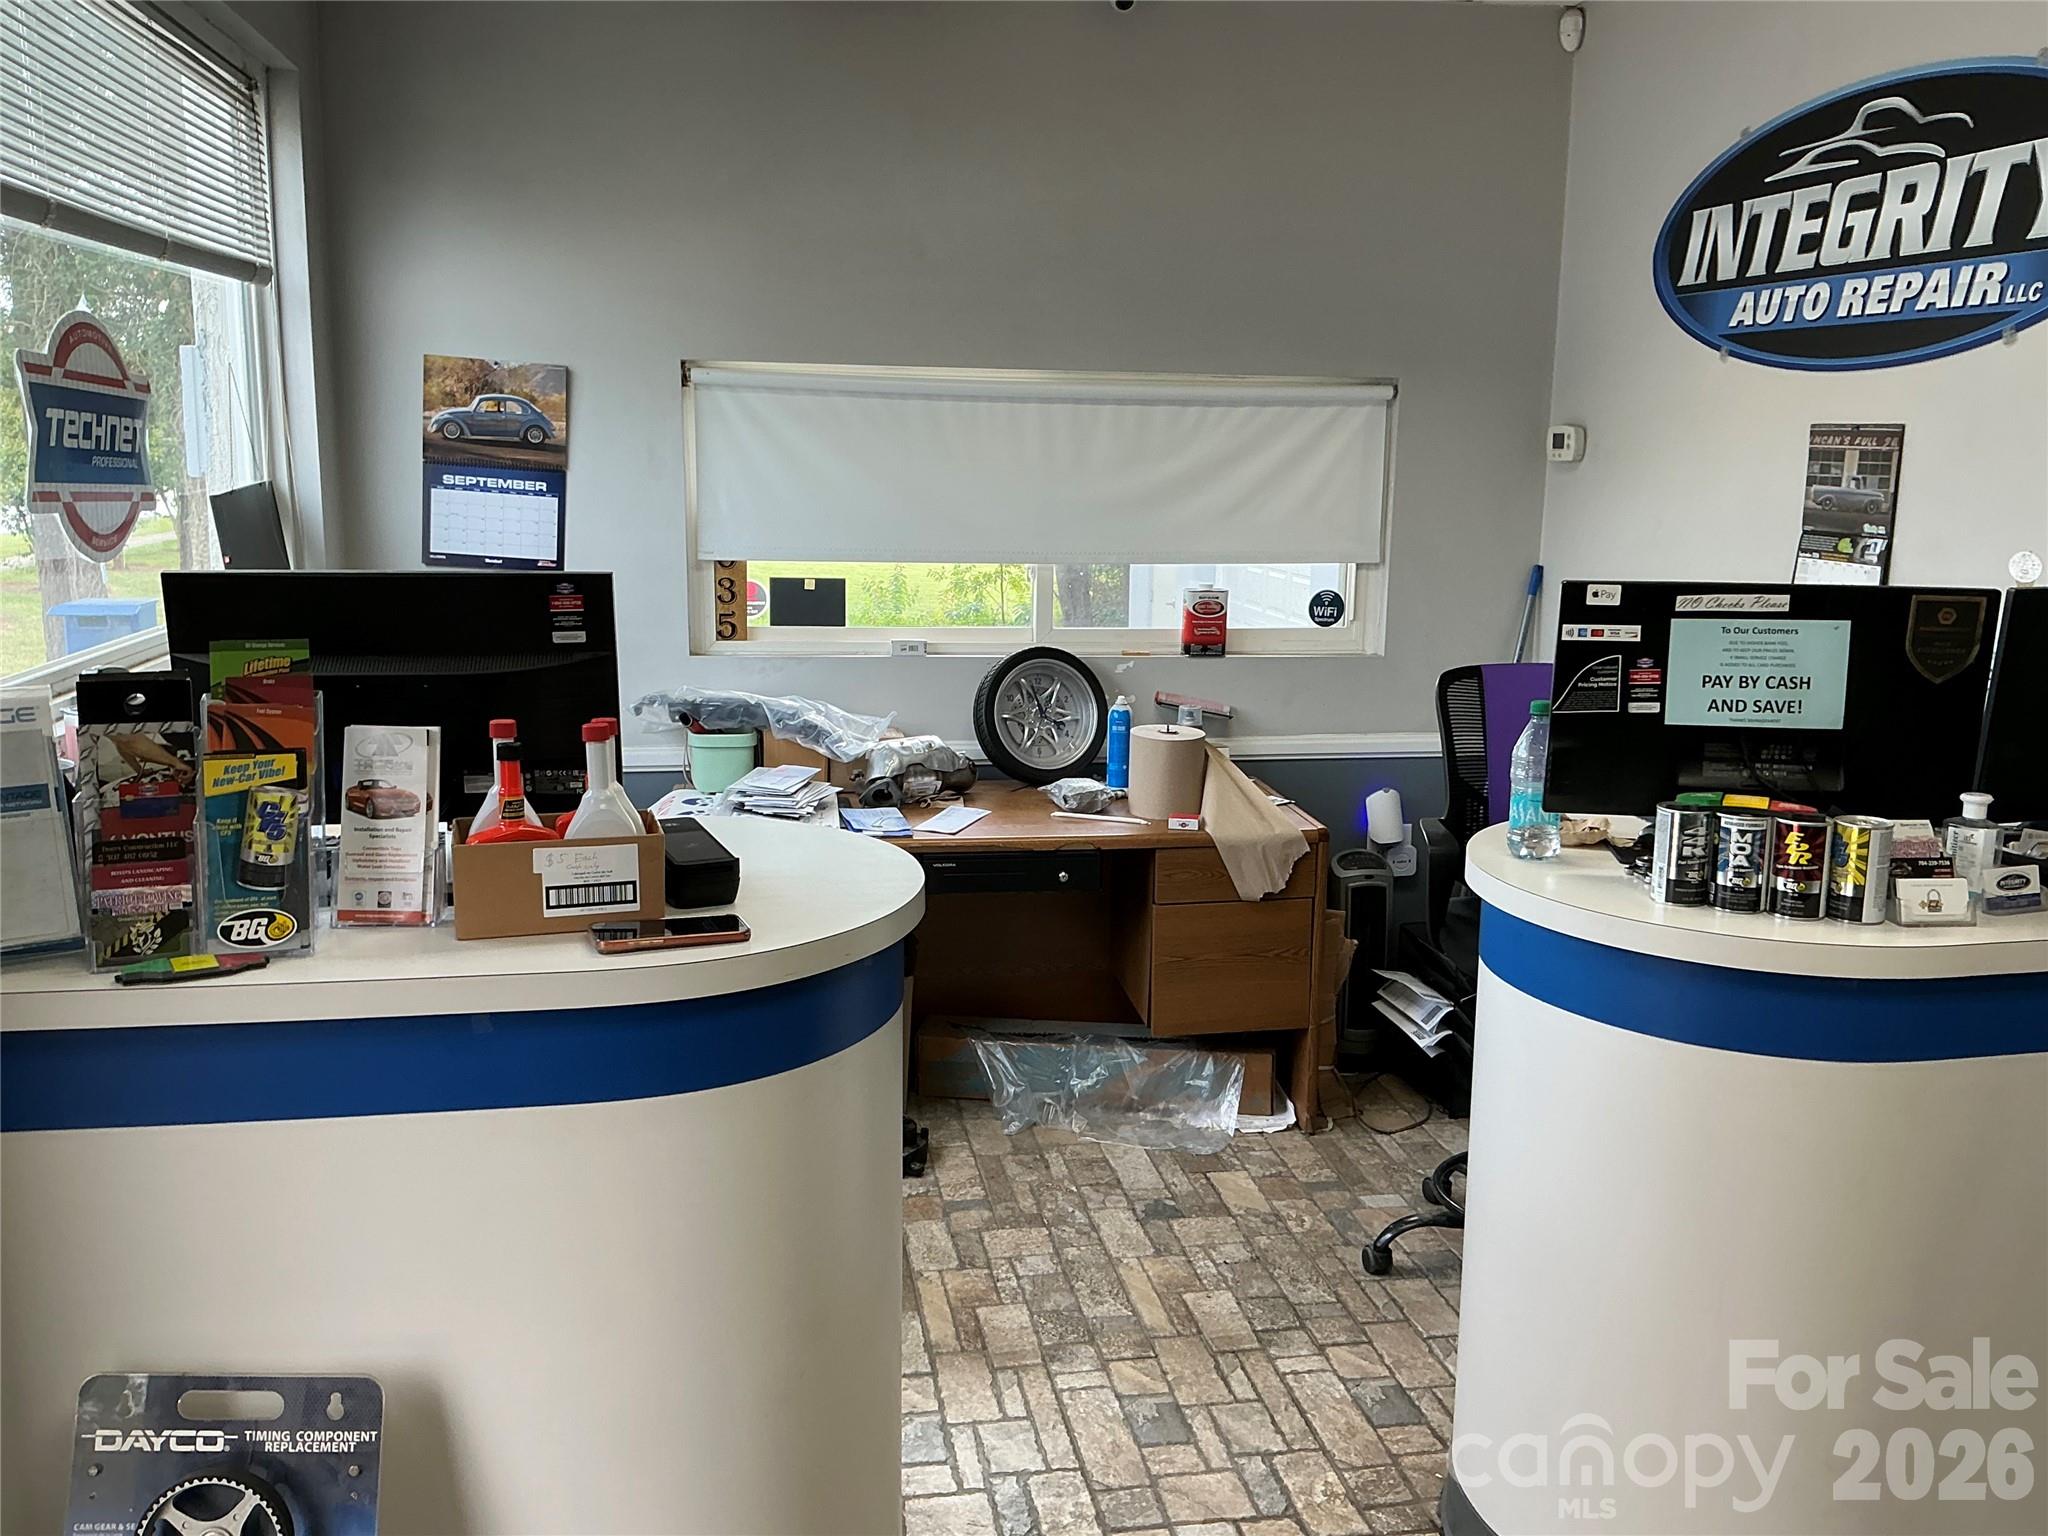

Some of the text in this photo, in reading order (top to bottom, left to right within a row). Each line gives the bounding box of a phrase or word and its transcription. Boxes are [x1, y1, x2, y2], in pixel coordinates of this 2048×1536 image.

[1728, 262, 2044, 328] AUTO REPAIR LLC
[92, 455, 138, 468] PROFESSIONAL
[442, 474, 547, 491] SEPTEMBER
[1600, 590, 1617, 600] Pay
[1704, 597, 1746, 609] Checks
[1750, 596, 1788, 609] Please
[1313, 606, 1337, 617] WiFi
[1721, 627, 1799, 635] To Our Customers
[243, 657, 290, 675] Lifetime
[1702, 675, 1811, 690] PAY BY CASH
[1707, 699, 1802, 713] AND SAVE!
[224, 759, 276, 775] Keep Your
[212, 766, 285, 788] New-Car Vibe!
[1730, 832, 1753, 867] MOA
[230, 917, 269, 941] BG
[94, 1430, 378, 1452] DAYCO TIMING COMPONENT
[264, 1441, 357, 1453] REPLACEMENT
[73, 1523, 138, 1531] CAM GEAR & SE
